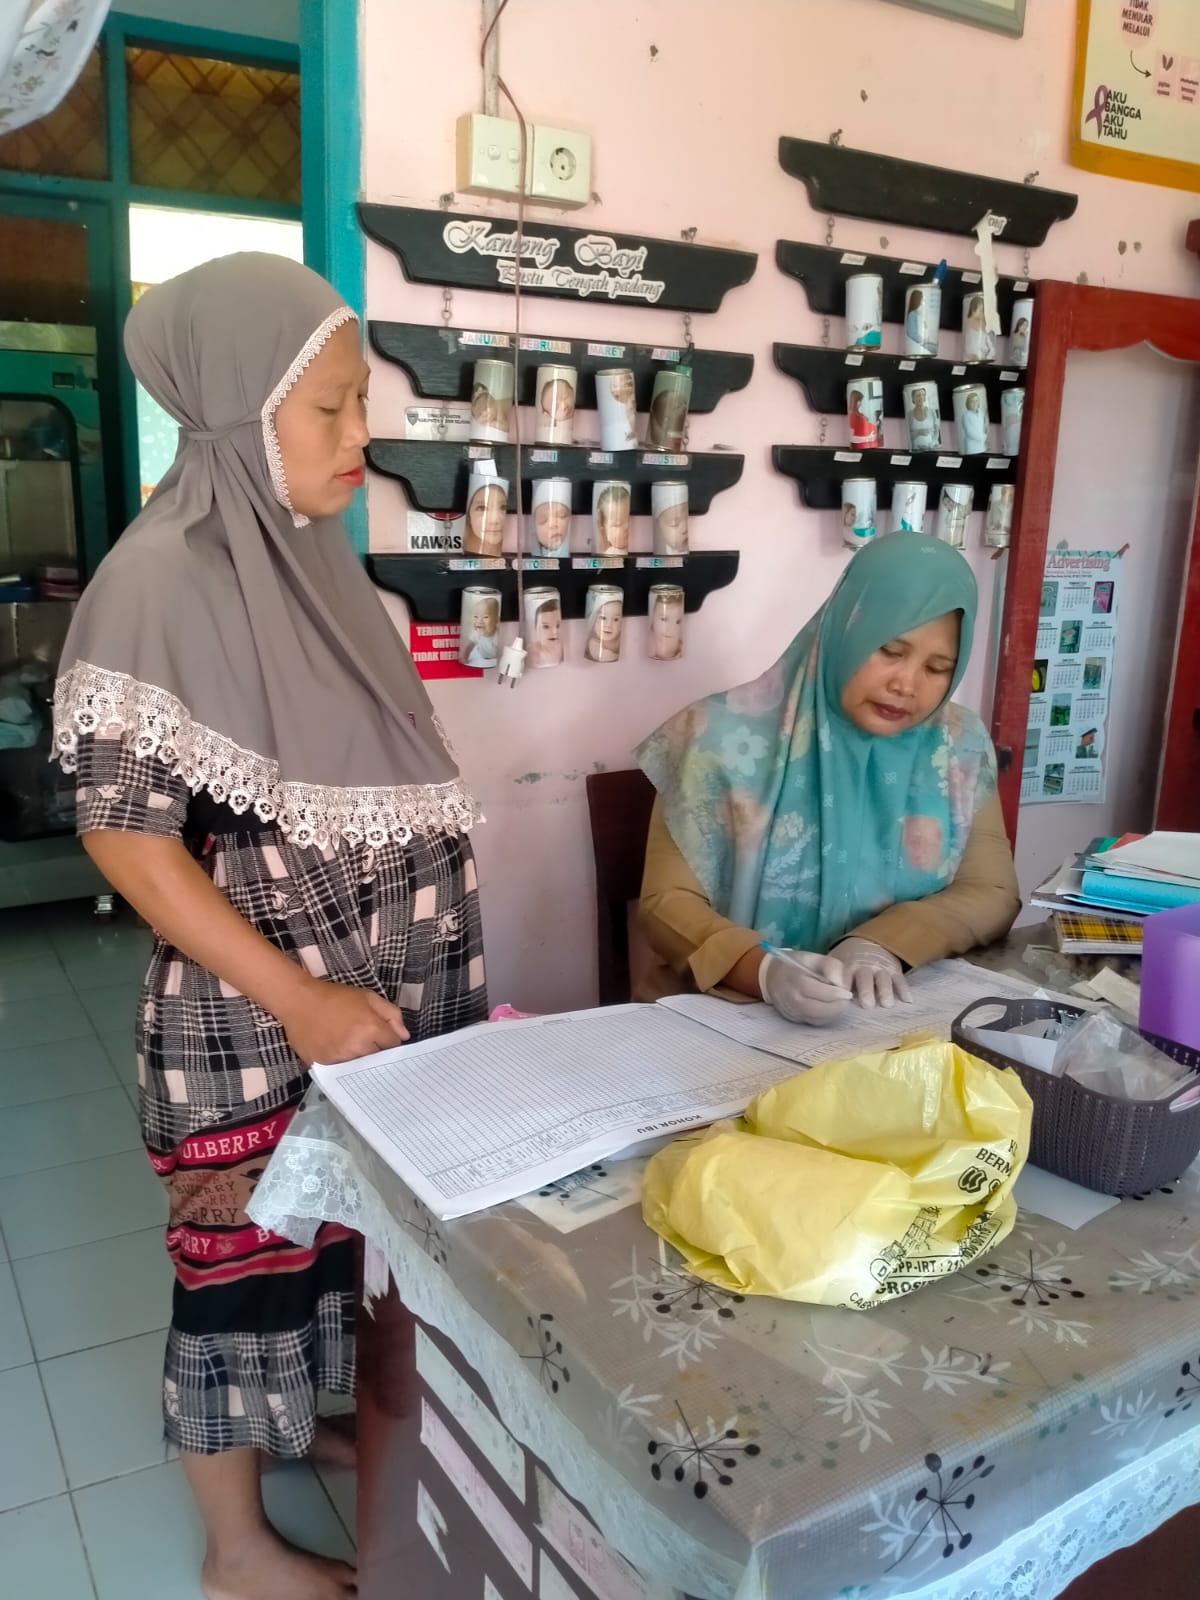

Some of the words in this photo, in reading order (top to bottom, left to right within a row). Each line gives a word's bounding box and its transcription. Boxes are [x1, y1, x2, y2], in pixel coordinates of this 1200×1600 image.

[1122, 9, 1153, 26] MENULAR
[1122, 21, 1151, 37] MELALUI
[1106, 90, 1127, 104] AKU
[1104, 102, 1142, 120] BANGGA
[1103, 114, 1124, 127] AKU
[1103, 125, 1127, 140] TAHU
